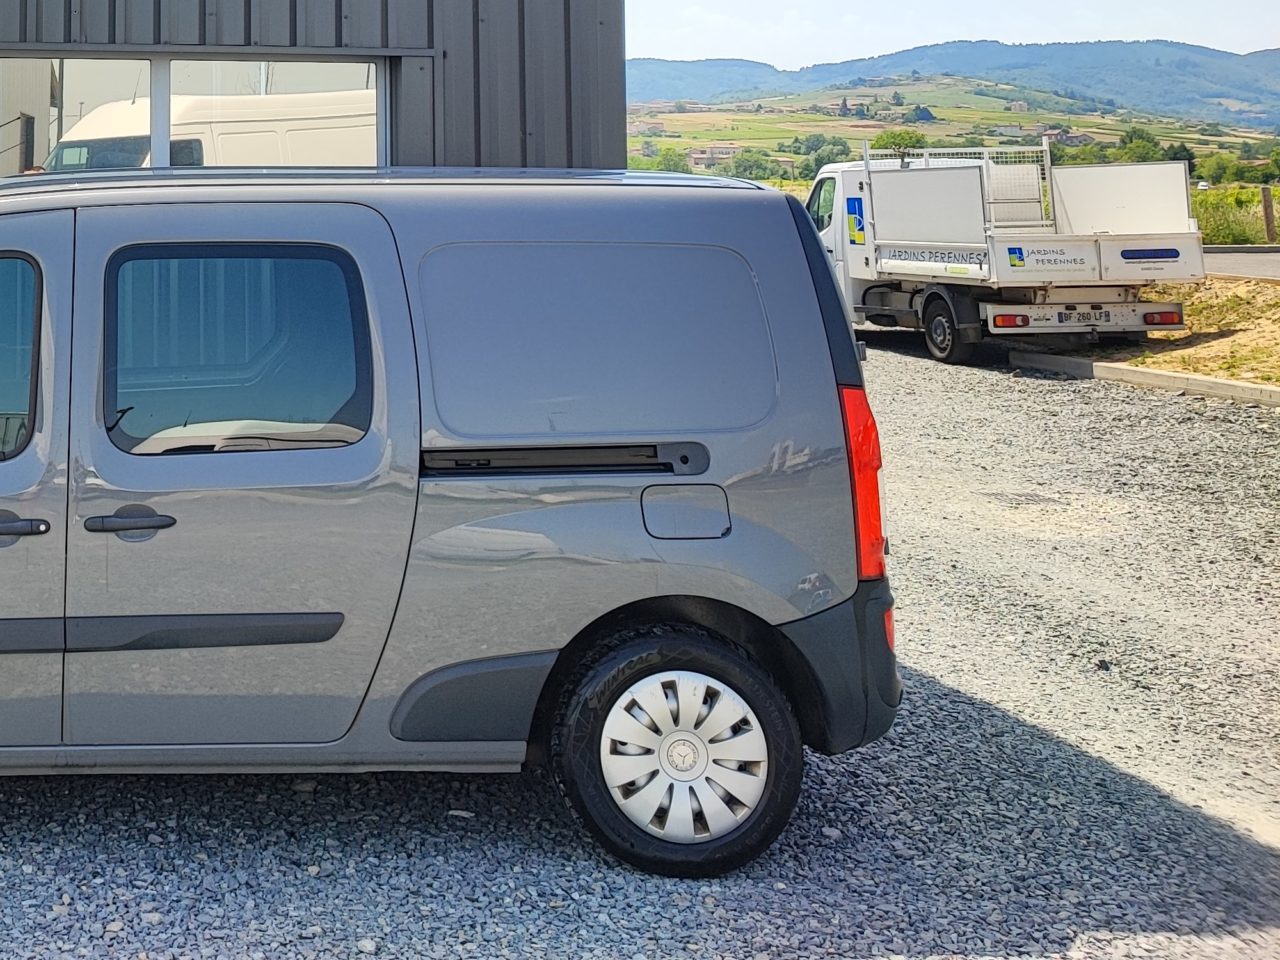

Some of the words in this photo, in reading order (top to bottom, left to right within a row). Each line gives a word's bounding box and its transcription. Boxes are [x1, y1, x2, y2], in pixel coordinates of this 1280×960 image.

[928, 250, 981, 265] PERENNES
[1026, 248, 1066, 258] JARDINS
[1035, 257, 1086, 266] PERENNES
